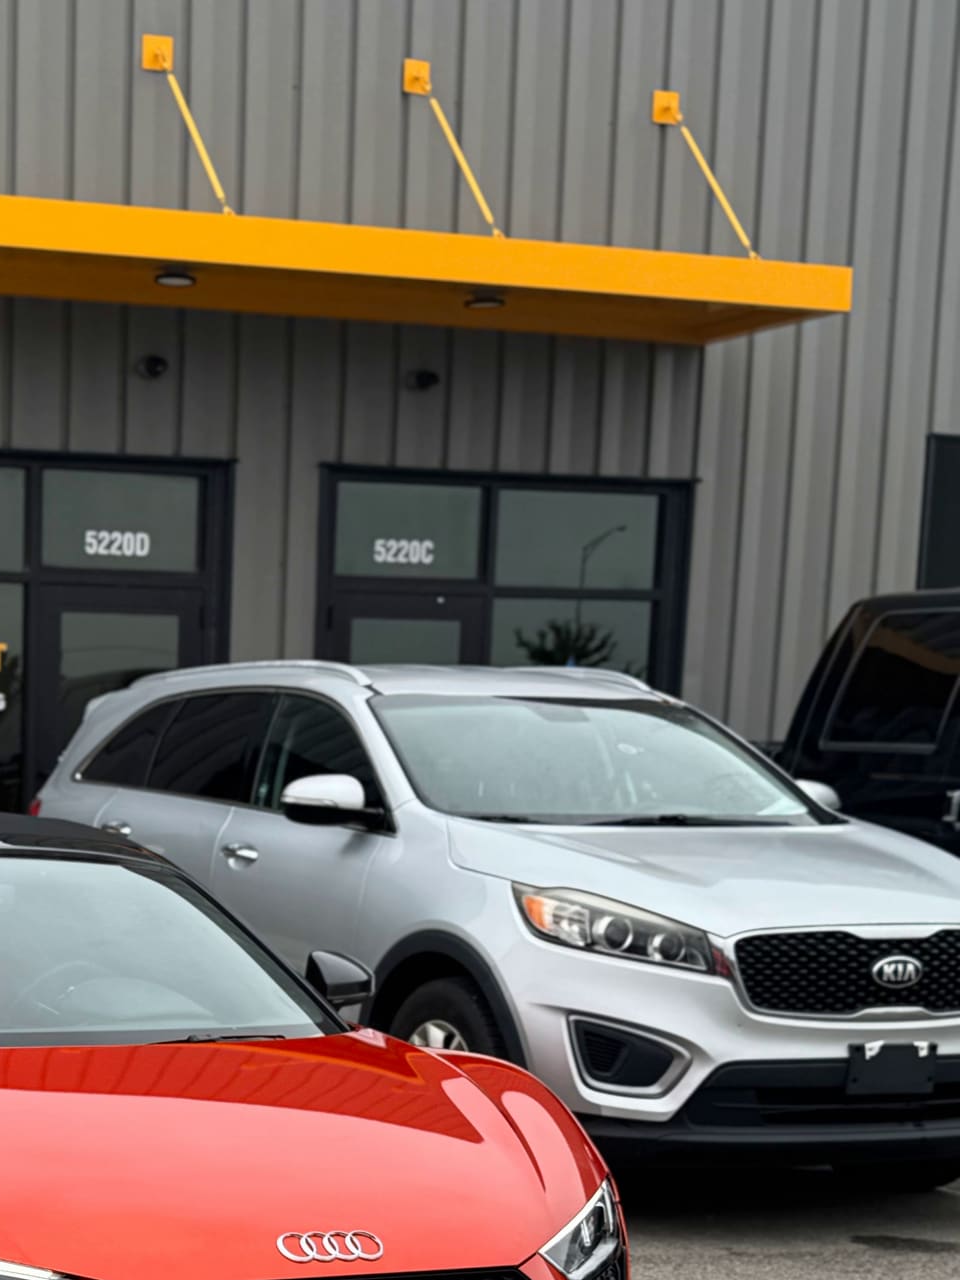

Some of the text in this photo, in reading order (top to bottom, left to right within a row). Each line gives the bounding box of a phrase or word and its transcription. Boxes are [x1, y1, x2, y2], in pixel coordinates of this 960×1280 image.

[84, 530, 150, 557] 5220D
[373, 538, 434, 565] 5220C
[883, 963, 916, 981] KIA
